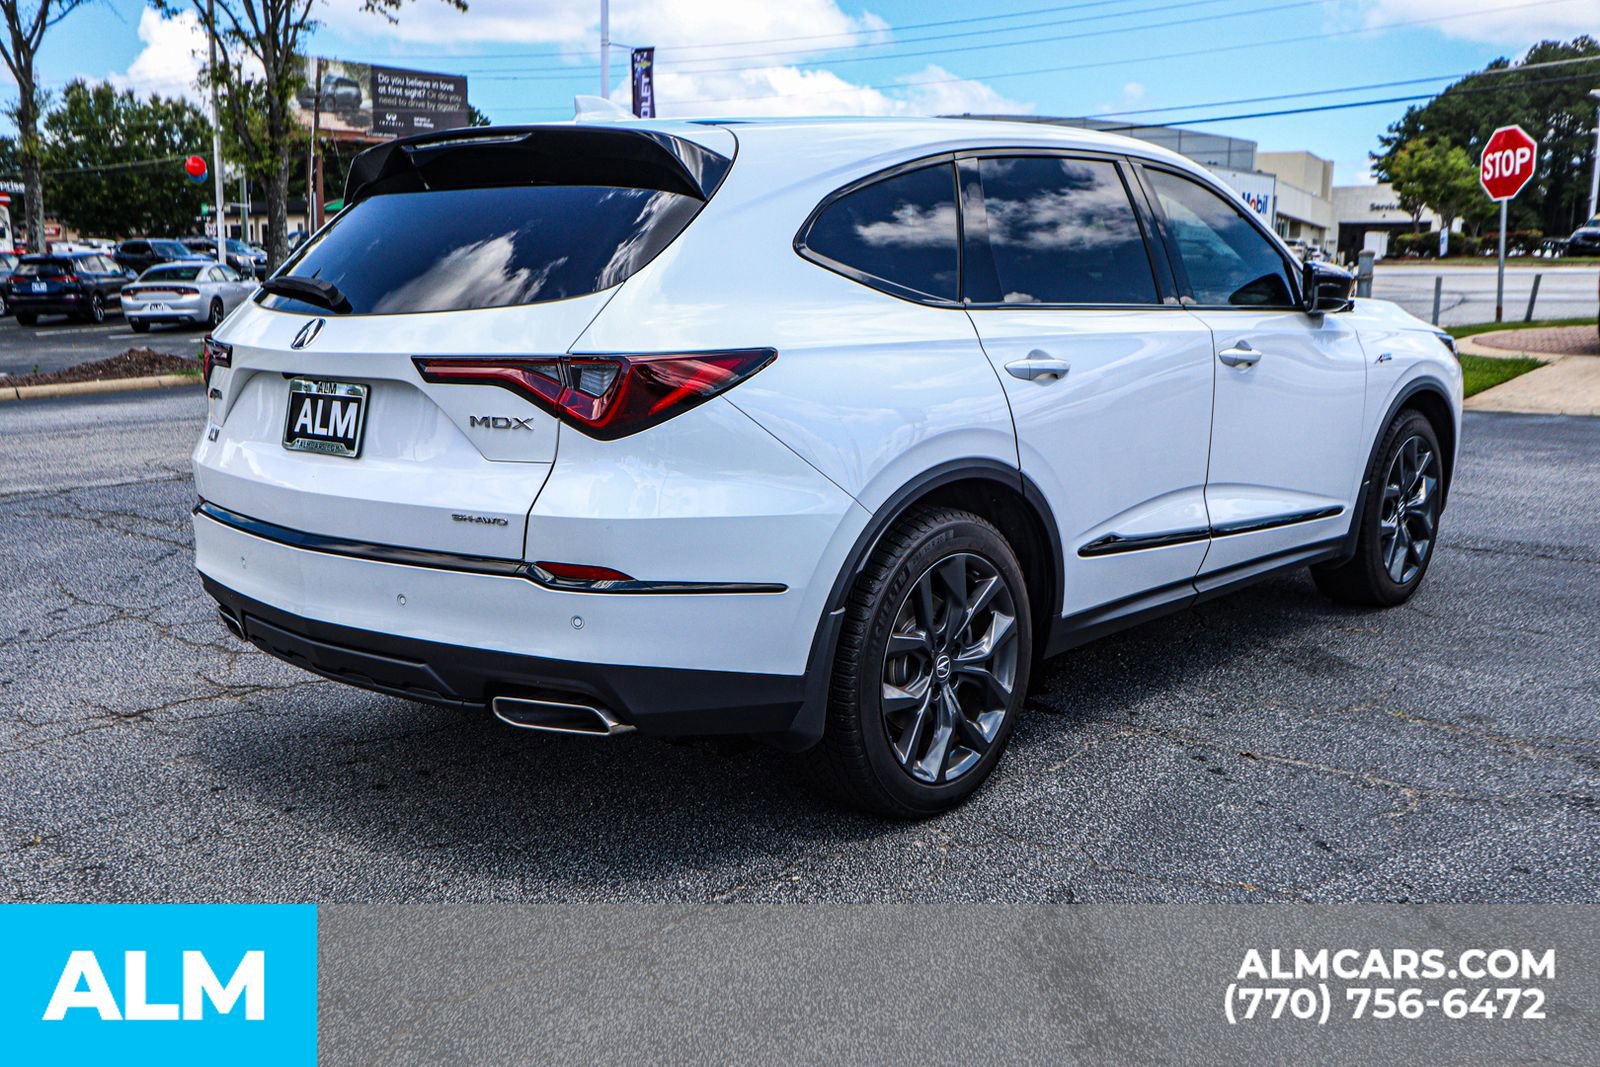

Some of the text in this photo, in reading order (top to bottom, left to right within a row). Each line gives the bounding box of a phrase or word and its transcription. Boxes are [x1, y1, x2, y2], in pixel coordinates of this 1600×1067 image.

[378, 73, 454, 92] Do you believe in love
[378, 85, 462, 103] at first sight? Or do you
[379, 97, 397, 106] need
[398, 98, 407, 106] to
[408, 99, 425, 109] drive
[427, 101, 435, 112] by
[379, 120, 404, 128] INFINITI
[1483, 146, 1531, 181] STOP
[1370, 202, 1400, 212] Servic
[317, 382, 337, 394] ALM
[294, 397, 358, 439] ALM
[469, 415, 534, 431] MDX
